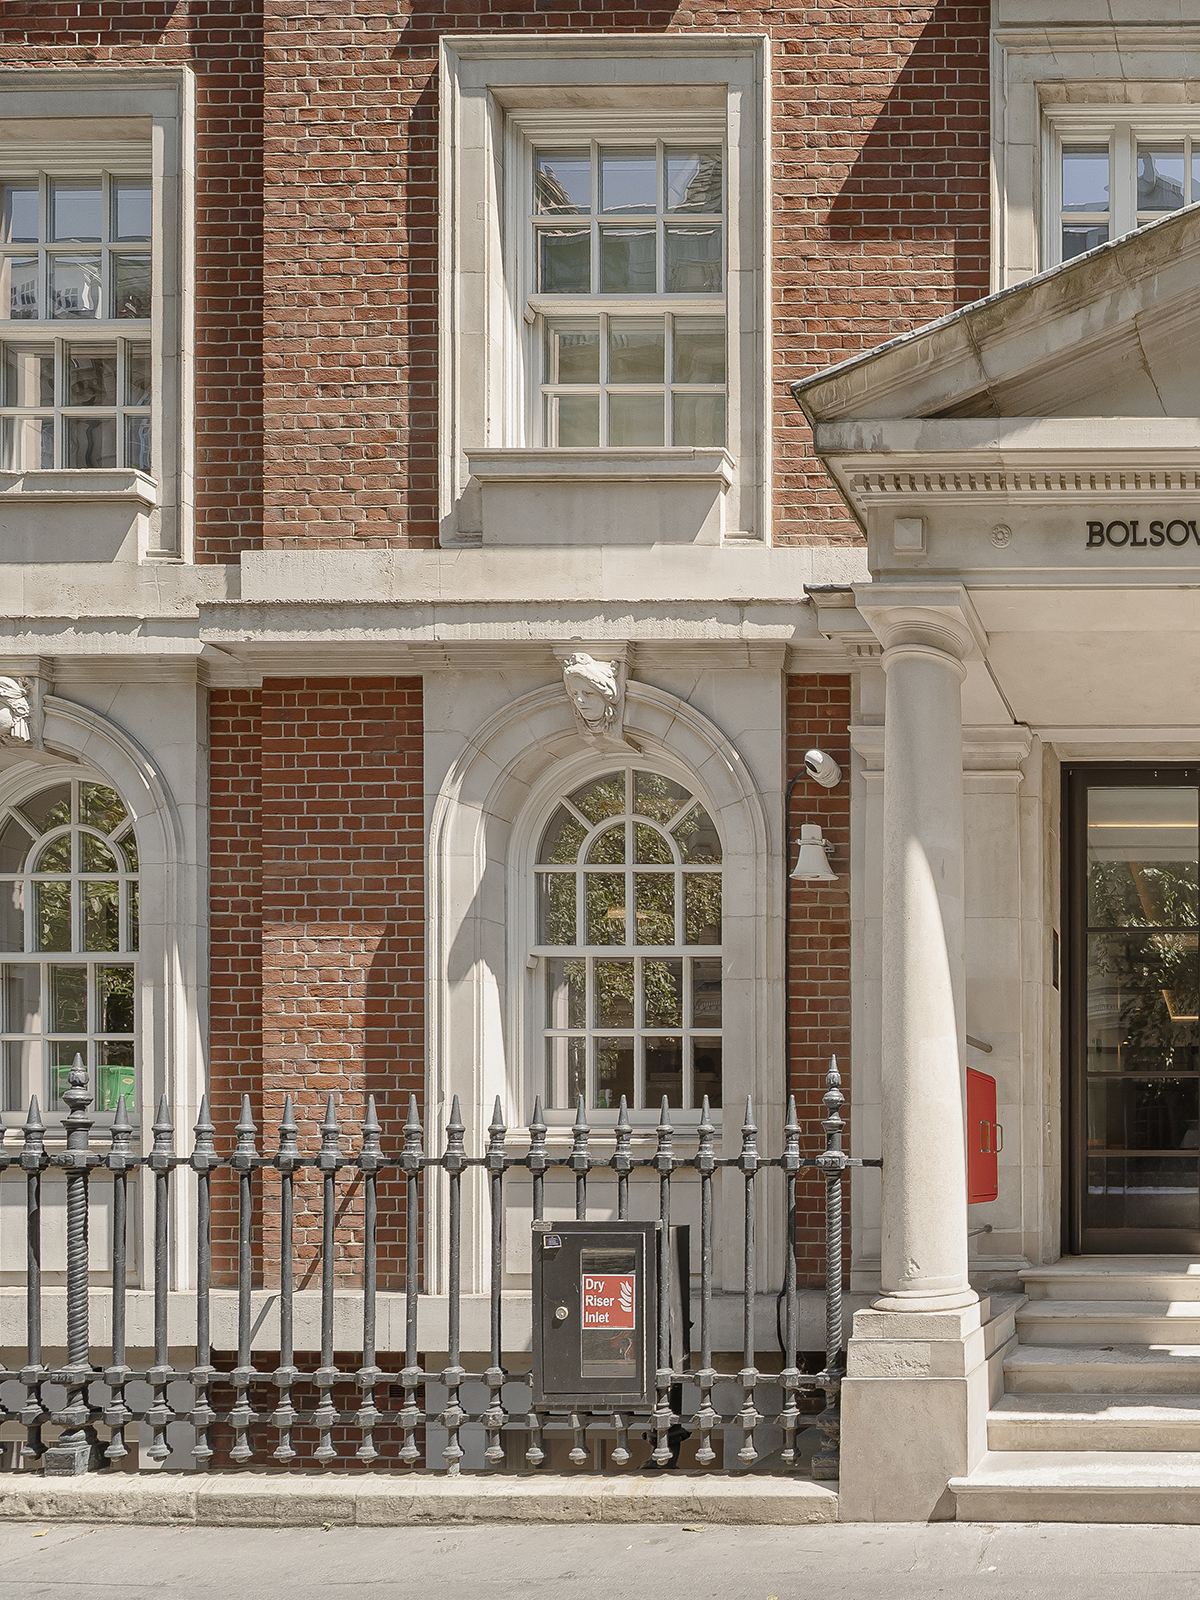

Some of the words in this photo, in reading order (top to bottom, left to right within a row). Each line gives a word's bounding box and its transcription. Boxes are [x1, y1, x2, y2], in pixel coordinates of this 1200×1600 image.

[585, 1278, 605, 1293] Dry
[585, 1294, 615, 1307] Riser
[585, 1311, 610, 1323] Inlet
